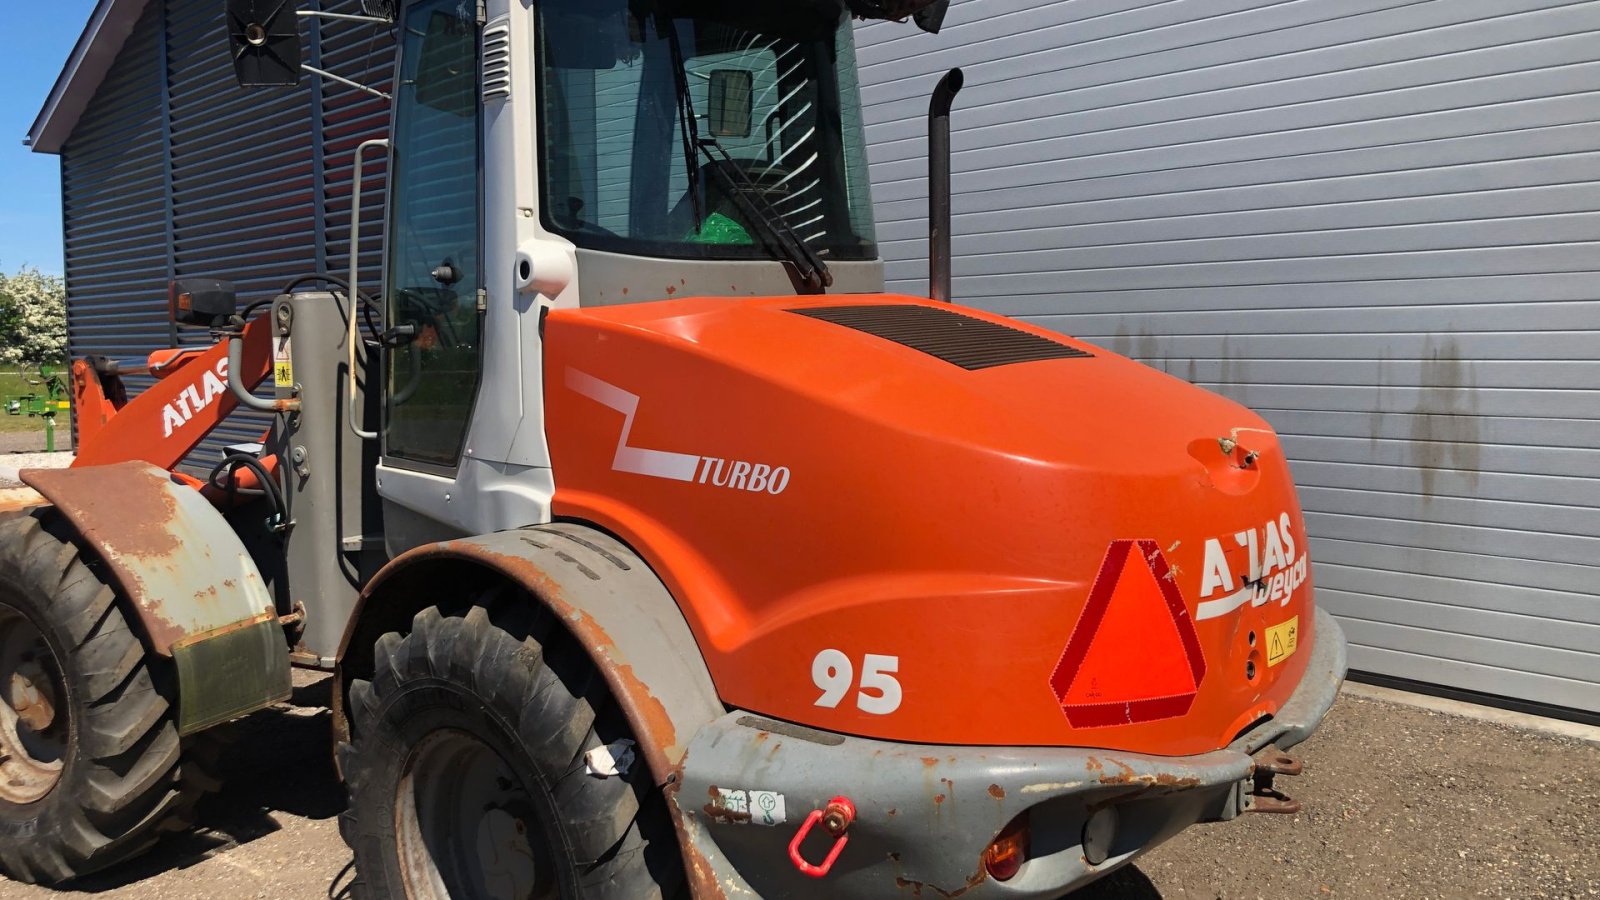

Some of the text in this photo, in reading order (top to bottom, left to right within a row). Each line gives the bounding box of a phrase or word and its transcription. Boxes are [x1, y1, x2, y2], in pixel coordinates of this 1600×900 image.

[699, 456, 791, 495] TURBO
[1200, 511, 1296, 598] ALAS
[811, 648, 903, 715] 95
